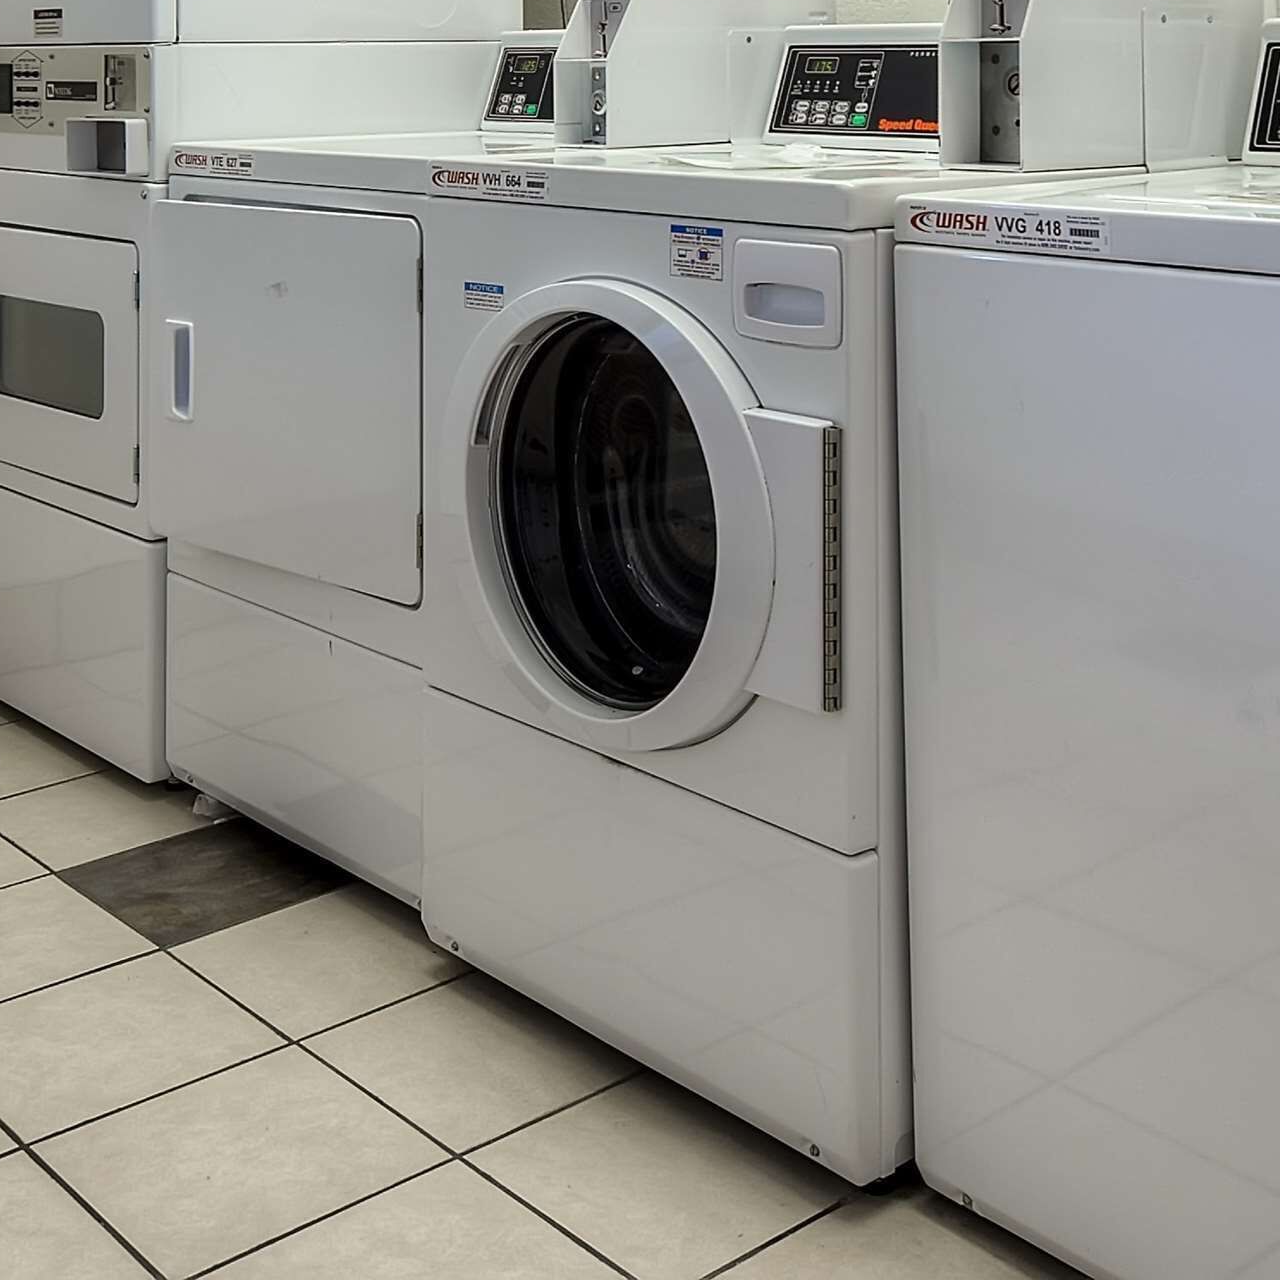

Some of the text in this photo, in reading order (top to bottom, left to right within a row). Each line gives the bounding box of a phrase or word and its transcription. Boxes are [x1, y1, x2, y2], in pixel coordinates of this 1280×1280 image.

[878, 118, 914, 132] Speed
[447, 170, 480, 186] WASH
[935, 211, 988, 232] WASH
[994, 216, 1027, 234] VVG
[1035, 219, 1062, 237] 418
